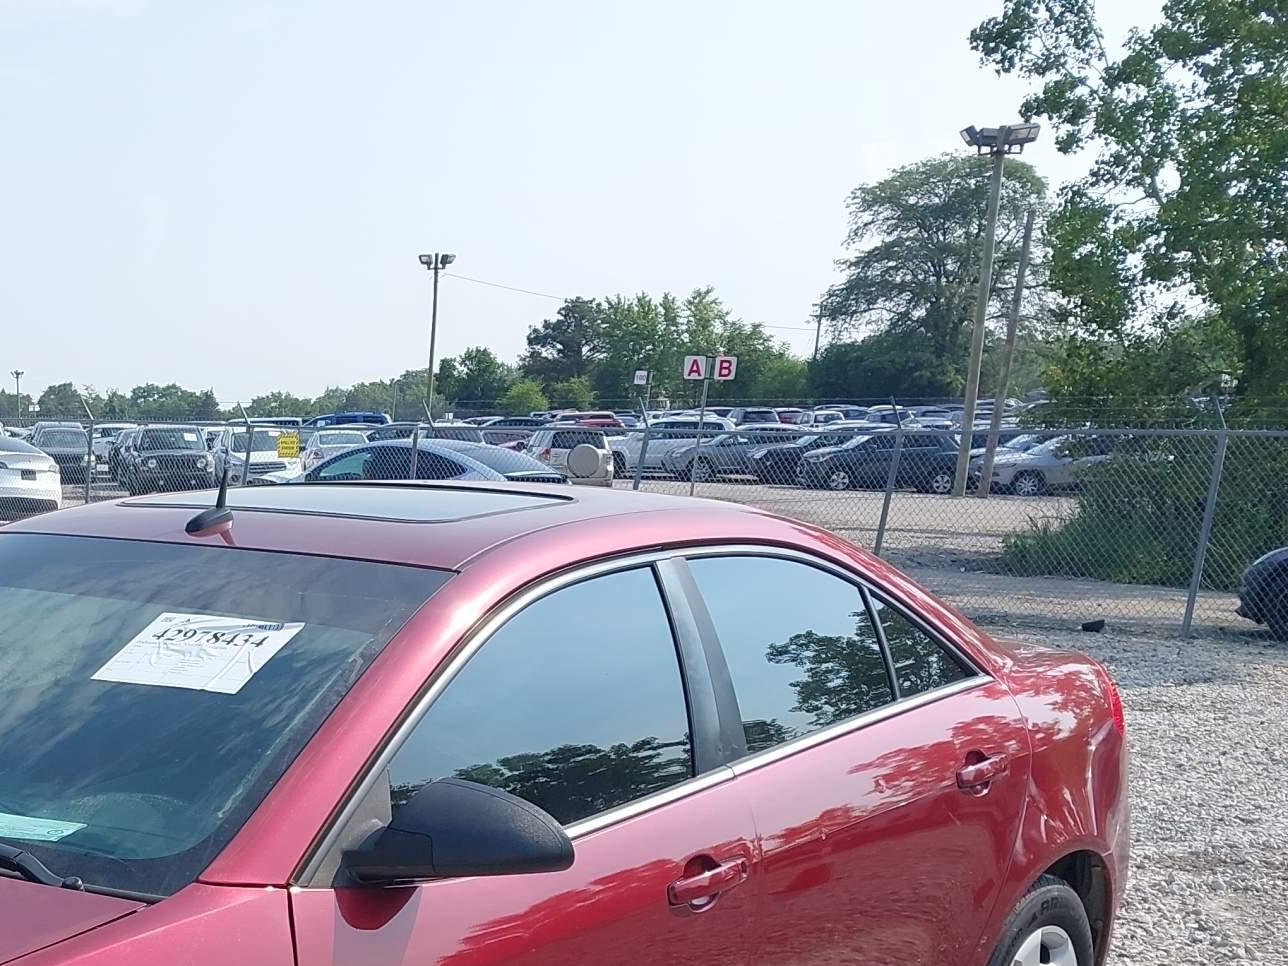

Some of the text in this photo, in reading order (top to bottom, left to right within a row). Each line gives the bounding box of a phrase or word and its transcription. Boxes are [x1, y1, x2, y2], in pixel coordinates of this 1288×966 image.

[688, 359, 702, 377] A
[718, 360, 733, 378] B
[152, 628, 270, 648] 42978434
